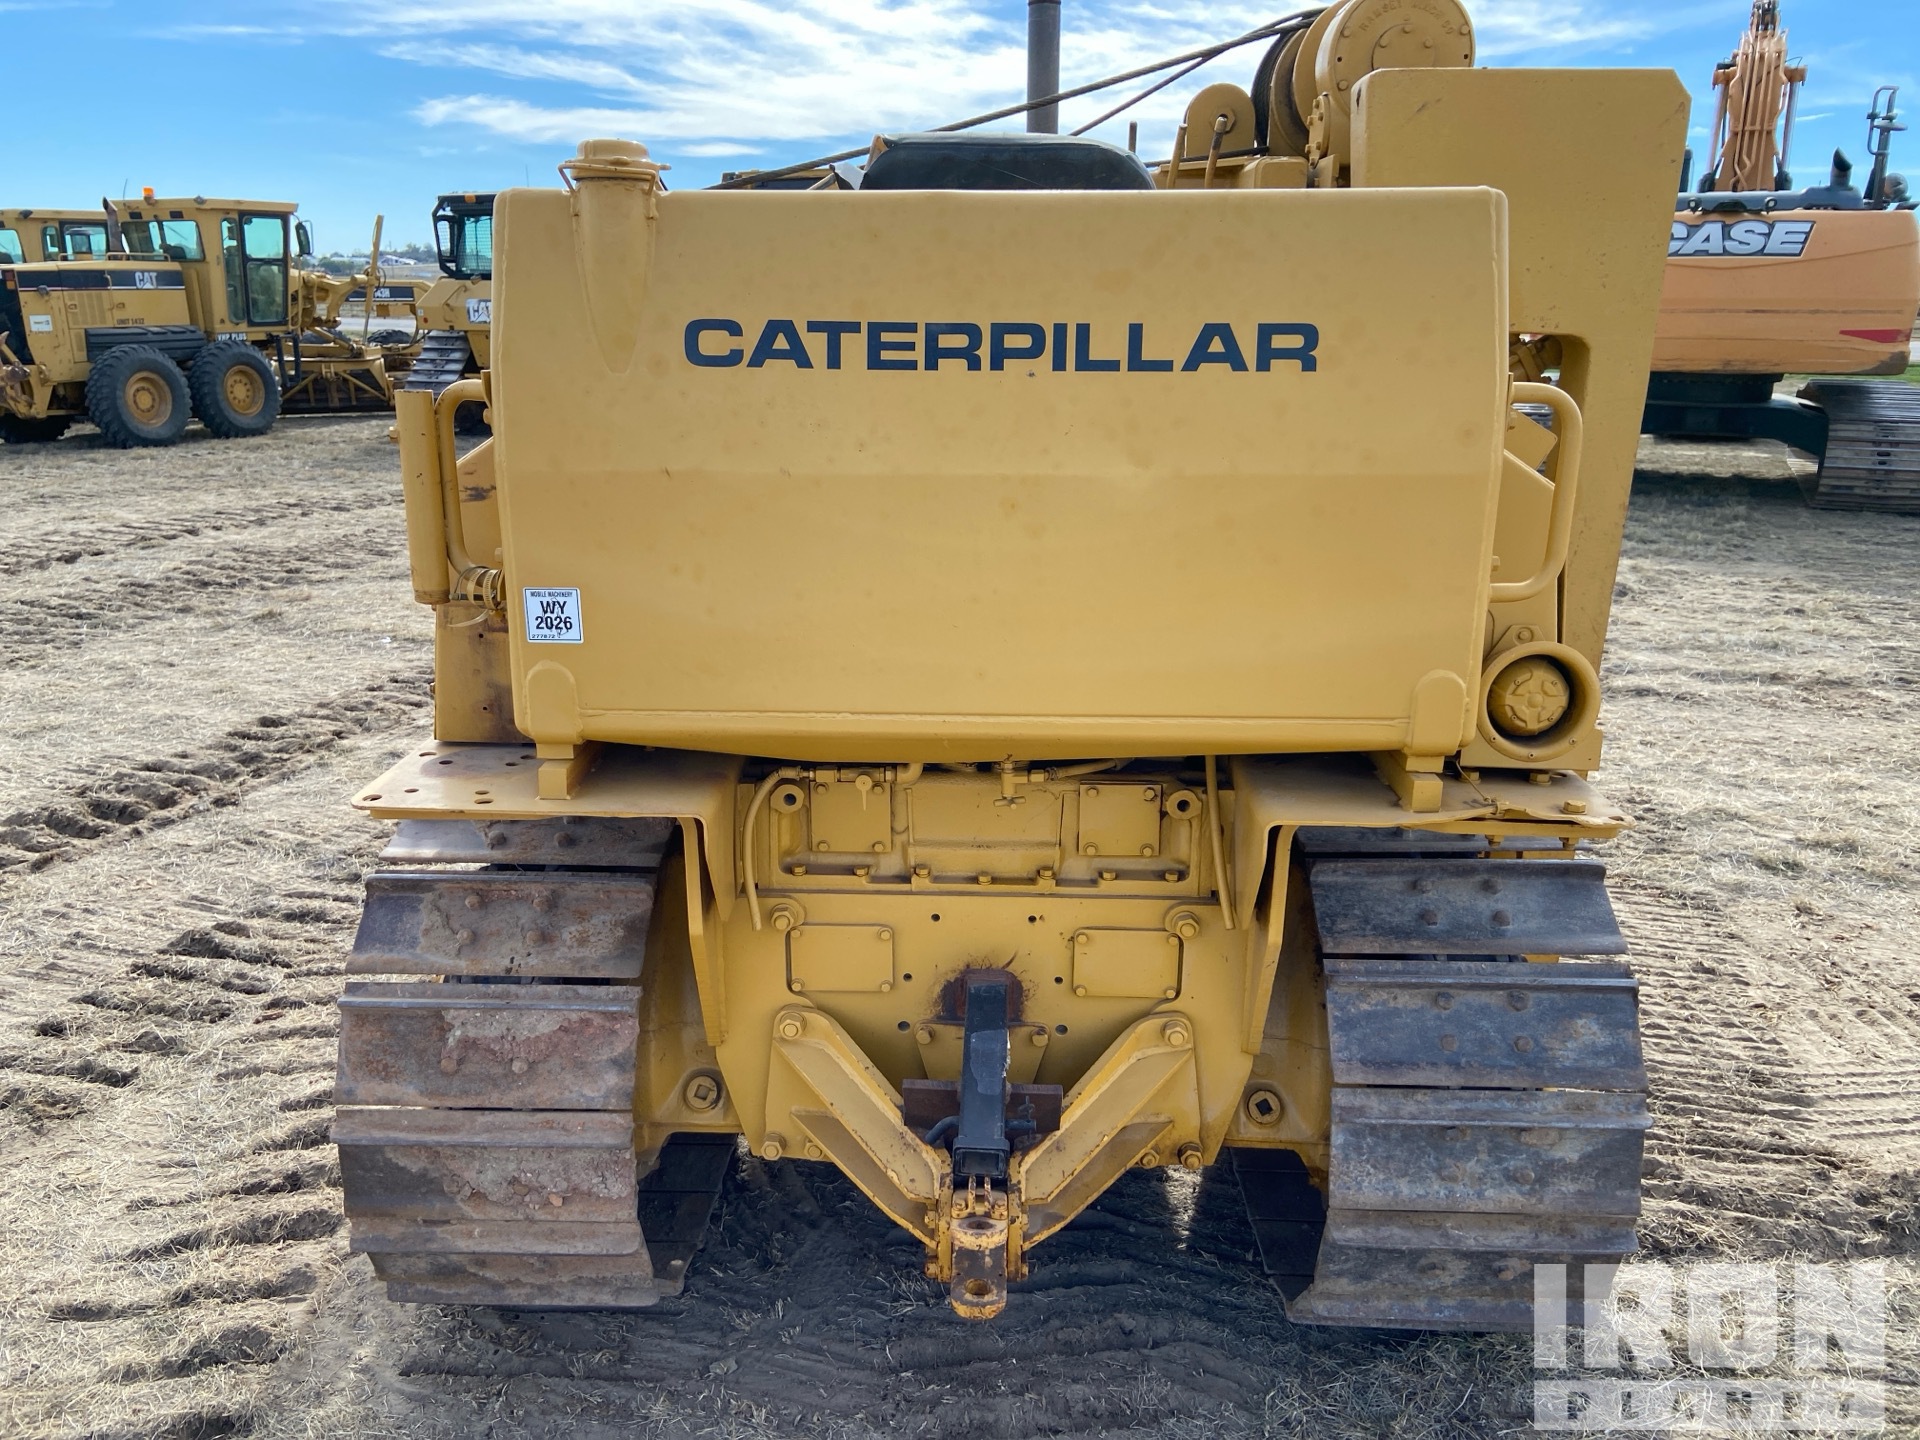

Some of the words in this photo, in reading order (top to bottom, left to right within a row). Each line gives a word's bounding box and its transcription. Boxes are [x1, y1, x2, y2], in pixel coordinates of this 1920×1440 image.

[135, 271, 157, 288] CAT
[685, 319, 1319, 372] CATERPILLAR
[540, 601, 567, 614] WY
[535, 616, 573, 630] 2026
